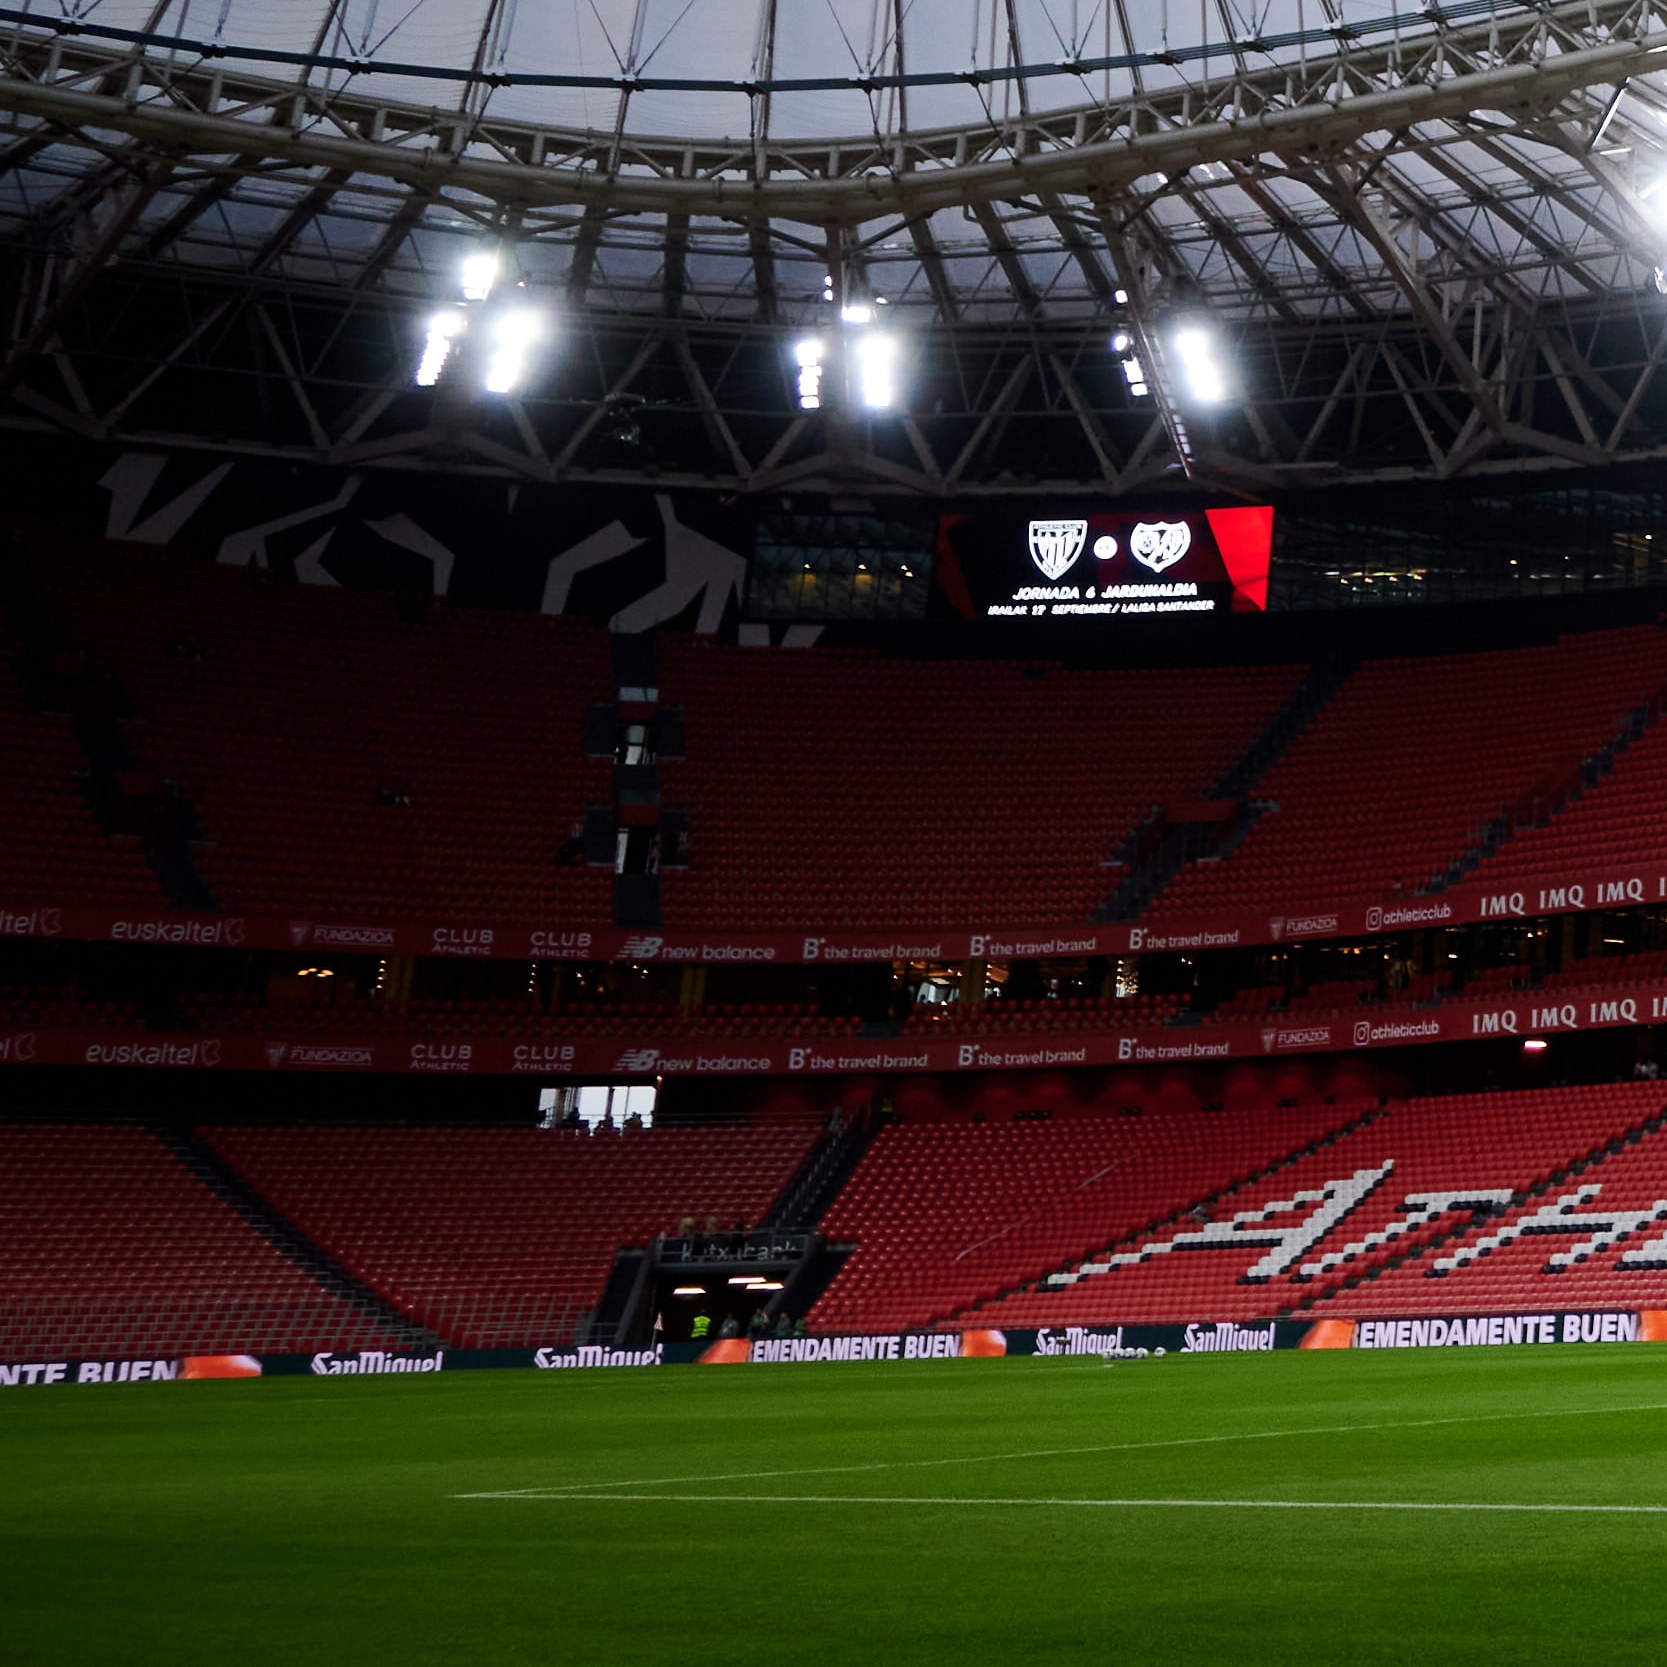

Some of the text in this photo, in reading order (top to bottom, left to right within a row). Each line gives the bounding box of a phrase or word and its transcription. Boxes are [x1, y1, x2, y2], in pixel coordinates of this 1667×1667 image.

[1012, 587, 1079, 600] JORNADA
[1540, 885, 1584, 908] IMQ
[1598, 879, 1643, 902] IMQ
[1481, 893, 1525, 916] IMQ
[1383, 904, 1451, 924] athleticclub
[112, 921, 221, 942] euskaltel
[433, 928, 493, 943] CLUB
[531, 932, 591, 946] CLUB
[1147, 937, 1166, 948] the
[1169, 933, 1202, 947] travel
[1204, 931, 1238, 944] brand
[432, 943, 490, 954] ATHLETIC
[530, 947, 588, 957] ATHLETIC
[663, 947, 698, 958] new
[703, 945, 775, 959] balance
[824, 946, 849, 958] the
[852, 946, 892, 958] travel
[897, 945, 940, 958] brand
[990, 943, 1013, 955] the
[1016, 940, 1053, 954] travel
[1057, 938, 1095, 952] brand
[1532, 1005, 1577, 1028] IMQ
[1591, 999, 1637, 1022] IMQ
[1371, 1021, 1439, 1039] athleticclub
[1473, 1010, 1517, 1033] IMQ
[86, 1043, 197, 1064] euskaltel
[412, 1044, 471, 1059] CLUB
[514, 1046, 574, 1060] CLUB
[979, 1053, 1002, 1065] the
[1005, 1051, 1042, 1064] travel
[1046, 1048, 1085, 1062] brand
[1136, 1046, 1155, 1058] the
[1157, 1044, 1192, 1058] travel
[1196, 1042, 1229, 1056] brand
[410, 1060, 469, 1070] ATHLETIC
[513, 1061, 571, 1071] ATHLETIC
[656, 1059, 693, 1070] new
[697, 1056, 771, 1070] balance
[811, 1056, 835, 1069] the
[838, 1056, 882, 1071] travel
[883, 1054, 928, 1070] brand
[1563, 1314, 1641, 1342] BUEN
[904, 1335, 964, 1359] BUEN
[78, 1361, 176, 1383] BUEN
